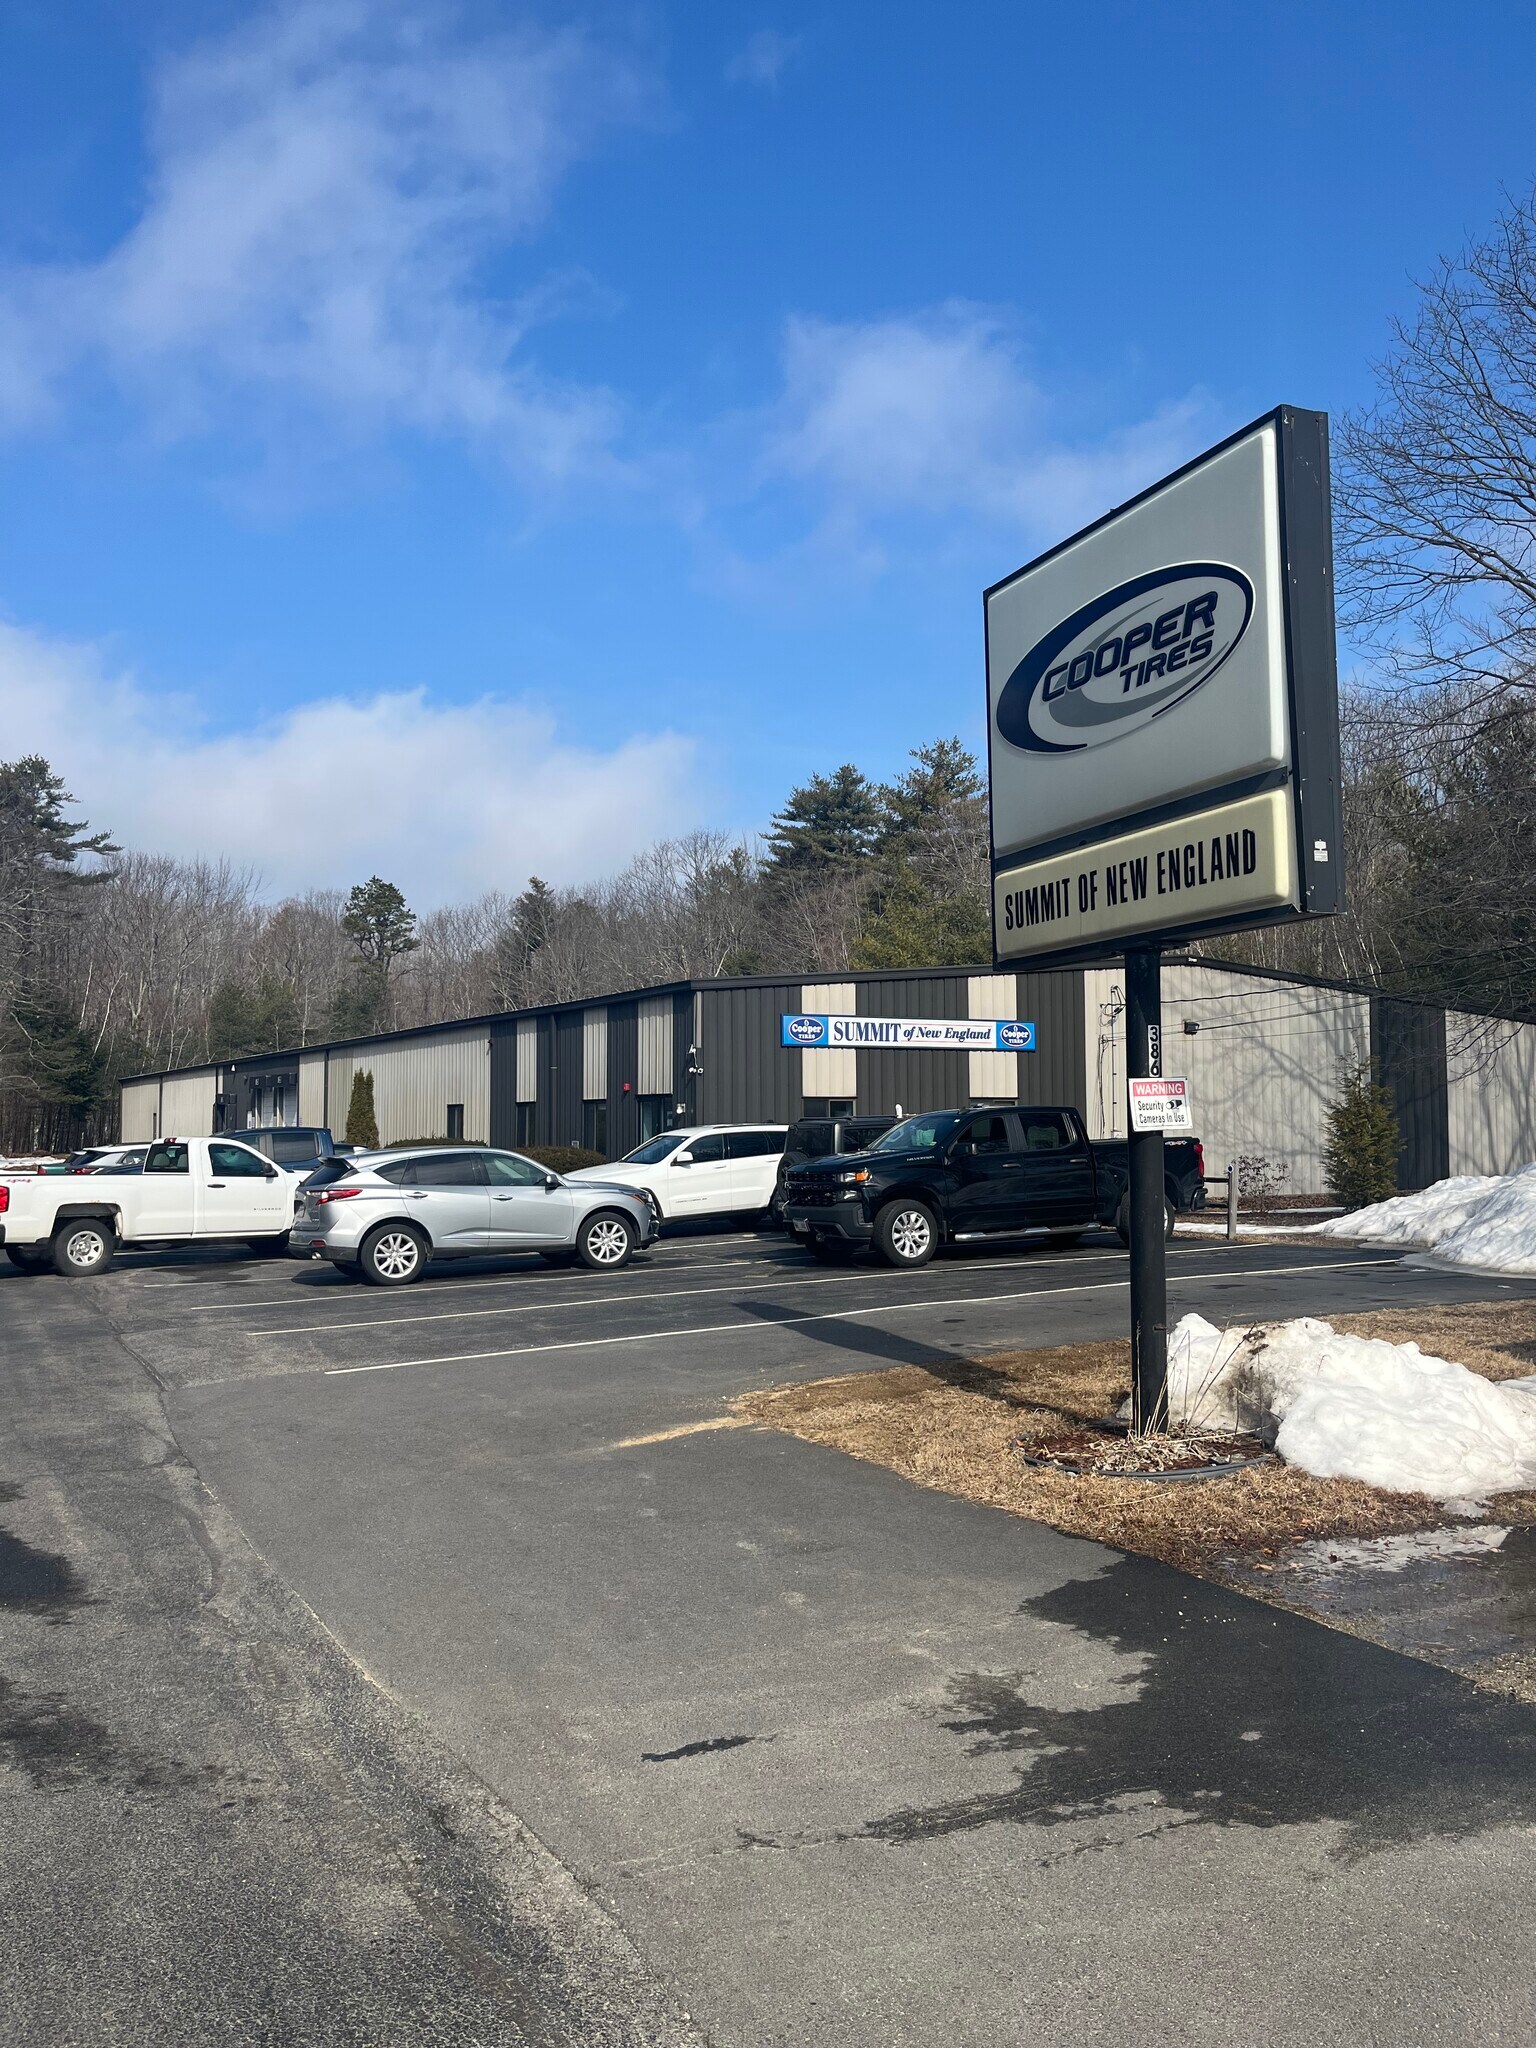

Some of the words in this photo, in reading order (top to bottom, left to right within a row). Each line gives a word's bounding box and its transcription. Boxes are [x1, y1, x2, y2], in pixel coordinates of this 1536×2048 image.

[1042, 591, 1218, 702] COOPER
[1119, 629, 1214, 693] TIRES
[1005, 878, 1070, 931] SUMMIT
[1078, 870, 1098, 913] OF
[1106, 856, 1148, 907] NEW
[1157, 829, 1256, 895] ENGLAND
[792, 1023, 821, 1034] Cooper
[834, 1021, 901, 1042] SUMMIT
[904, 1026, 916, 1041] of
[916, 1027, 941, 1039] New
[944, 1028, 991, 1043] England
[1003, 1029, 1029, 1039] Cooper
[1150, 1026, 1159, 1076] 386
[1135, 1083, 1182, 1095] WARNING
[1138, 1101, 1164, 1112] Security
[1139, 1113, 1165, 1123] Cameras
[1166, 1113, 1173, 1122] In
[1174, 1112, 1185, 1122] Use
